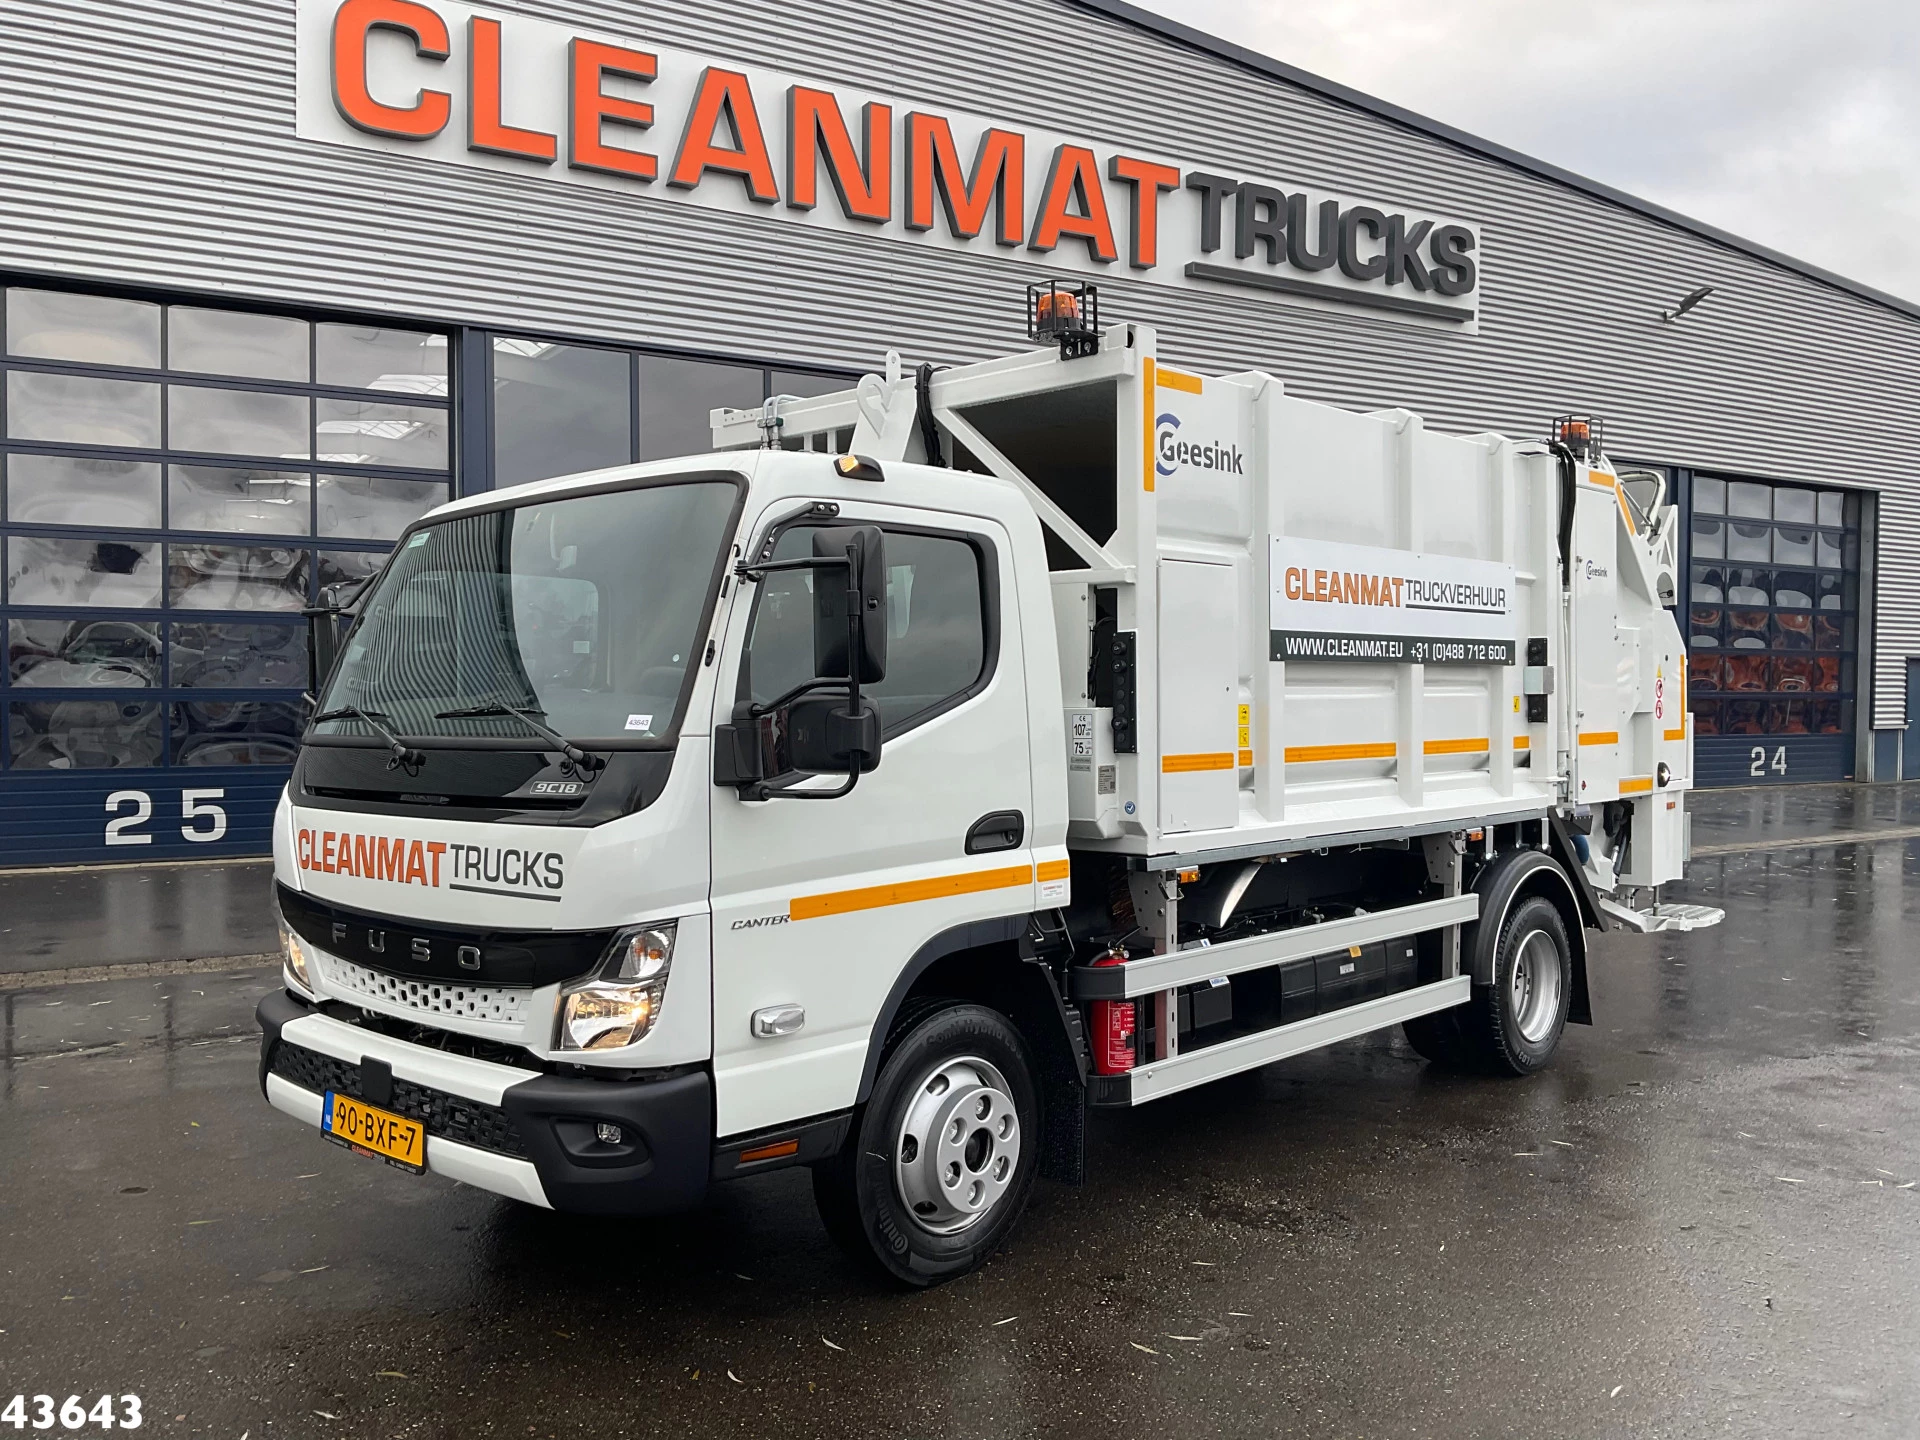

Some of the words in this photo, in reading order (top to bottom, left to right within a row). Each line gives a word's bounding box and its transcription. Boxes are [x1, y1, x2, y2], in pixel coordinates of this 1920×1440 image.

[330, 0, 1180, 268] CLEANMAT
[1186, 171, 1476, 296] TRUCKS
[1159, 430, 1243, 475] Geesink
[1285, 566, 1404, 608] CLEANMAT
[1405, 579, 1506, 608] TRUCKVERHUUR
[1285, 637, 1403, 658] WWW.CLEANMAT.EU
[1410, 642, 1429, 660] +31
[1432, 643, 1464, 661] (0)488
[1467, 644, 1486, 660] 712
[1488, 645, 1507, 660] 600
[1073, 724, 1086, 736] 107
[1074, 742, 1084, 754] 75
[1750, 745, 1787, 777] 24
[534, 783, 578, 794] 9C18
[298, 828, 447, 888] CLEANMAT
[449, 842, 564, 890] TRUCKS
[731, 914, 791, 931] CANTER
[331, 922, 481, 971] FUSO
[338, 1101, 417, 1157] 90-BXF-7
